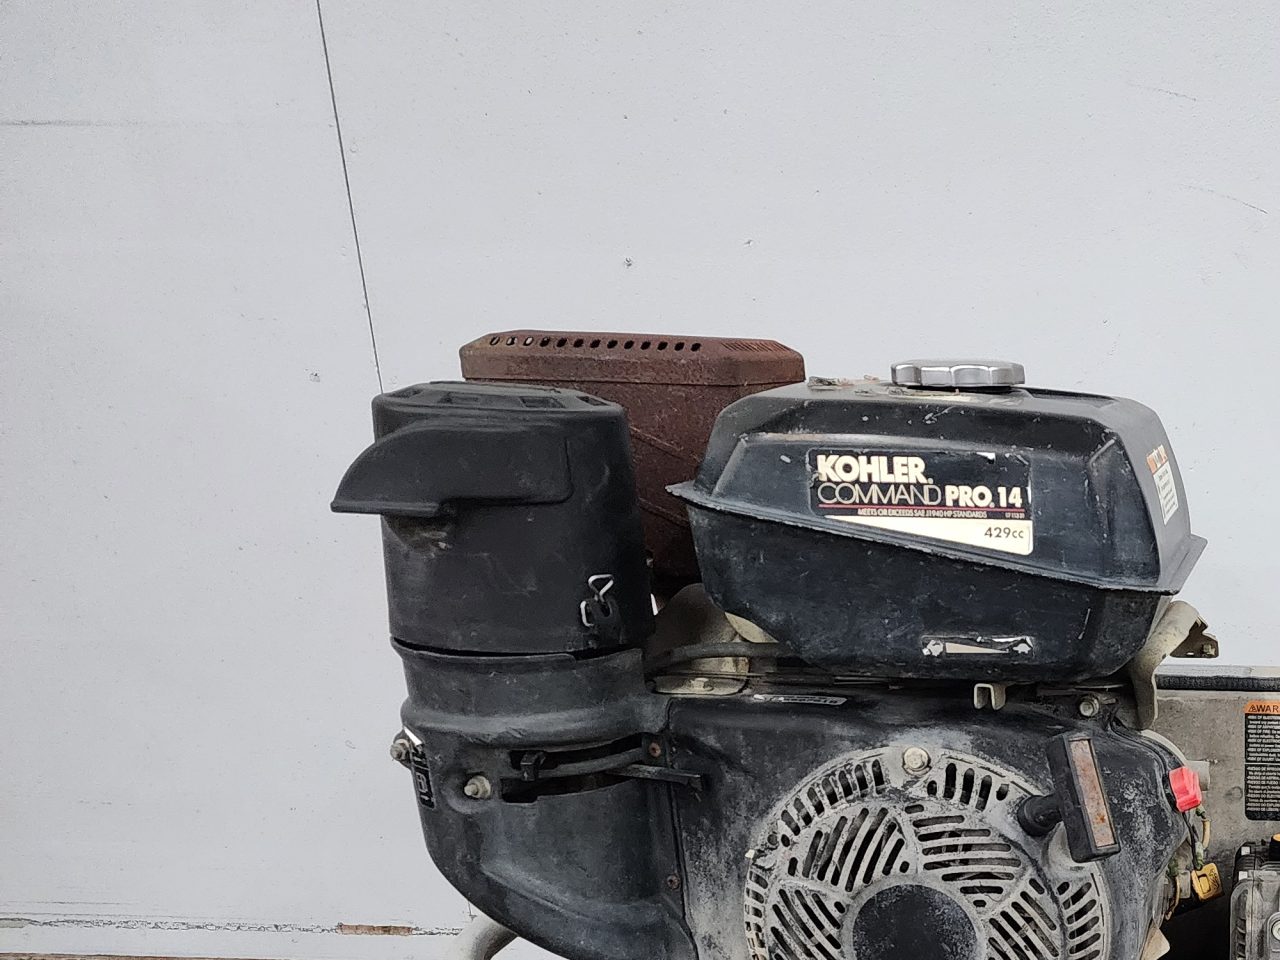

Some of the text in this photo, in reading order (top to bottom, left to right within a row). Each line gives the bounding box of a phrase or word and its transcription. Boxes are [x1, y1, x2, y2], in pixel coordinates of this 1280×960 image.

[817, 482, 942, 505] COMMAND
[998, 486, 1023, 508] 14
[984, 527, 1024, 540] 429cc
